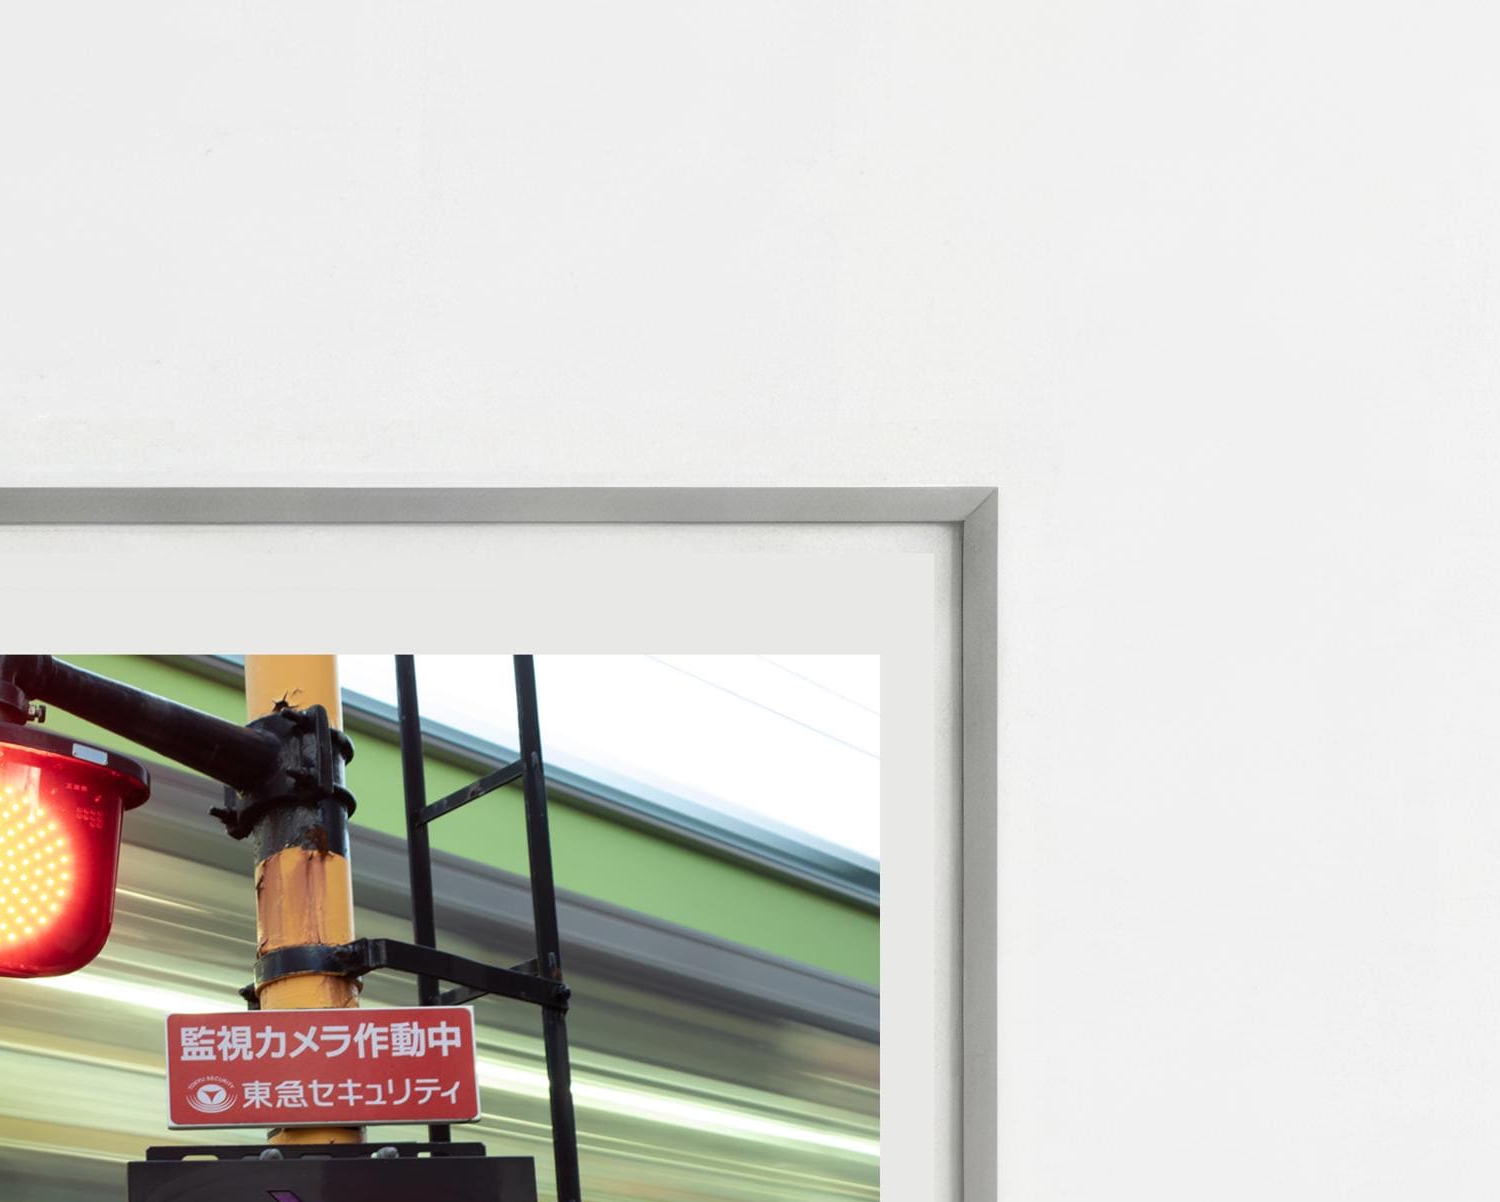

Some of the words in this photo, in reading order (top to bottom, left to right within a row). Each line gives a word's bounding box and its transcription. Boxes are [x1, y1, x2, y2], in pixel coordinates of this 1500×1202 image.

[180, 1020, 462, 1062] 監視カメラ作動中
[242, 1078, 460, 1109] 東急セキュリティ
